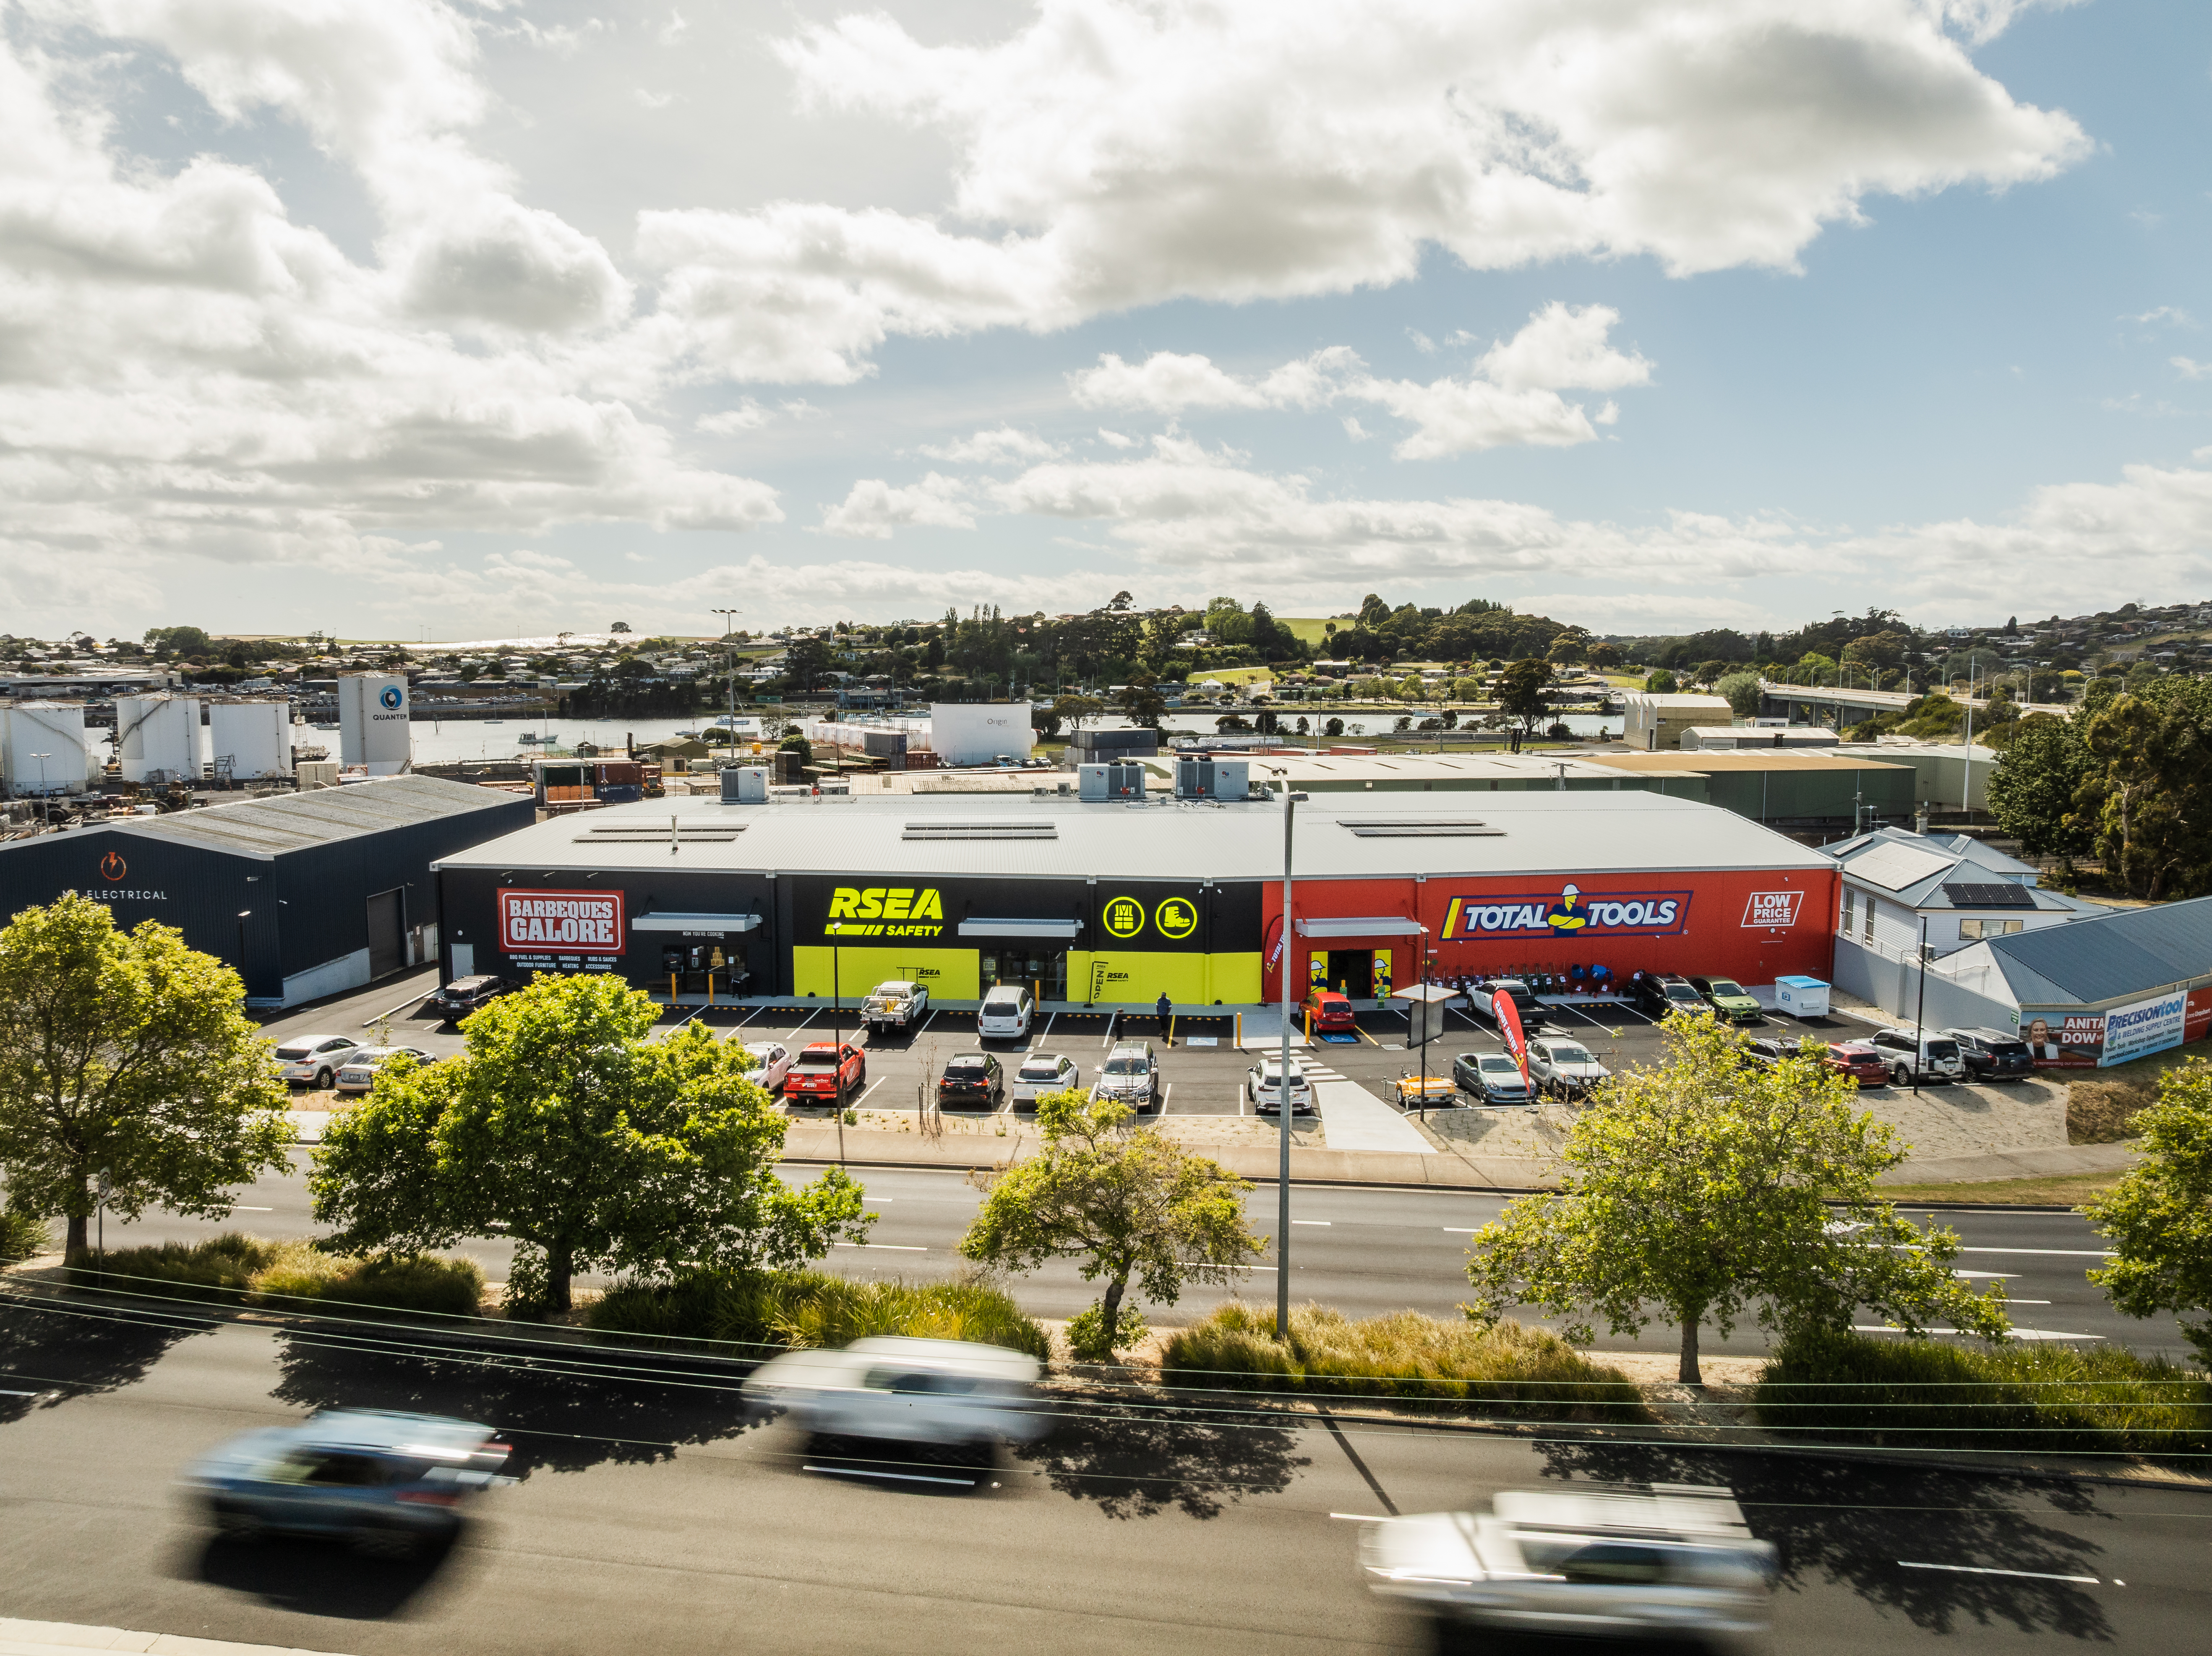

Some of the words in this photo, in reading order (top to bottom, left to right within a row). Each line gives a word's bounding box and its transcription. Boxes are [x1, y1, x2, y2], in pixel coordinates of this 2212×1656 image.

[87, 890, 167, 899] ELECTRICAL
[828, 888, 943, 919] RSEA
[1754, 894, 1791, 908] LOW
[509, 900, 613, 920] BARBEQUES
[1466, 905, 1548, 930] TOTAL
[1589, 901, 1677, 926] TOOLS
[1754, 908, 1791, 918] PRICE
[511, 917, 614, 943] GALORE
[886, 925, 943, 936] SAFETY
[1271, 943, 1283, 962] TOTAL
[1093, 970, 1104, 999] OPEN
[2065, 1018, 2104, 1029] ANITA
[2122, 1026, 2144, 1038] WELDING
[2145, 1021, 2163, 1032] SUPPLY
[2163, 1015, 2181, 1026] CENTRE
[2061, 1032, 2097, 1043] DOW
